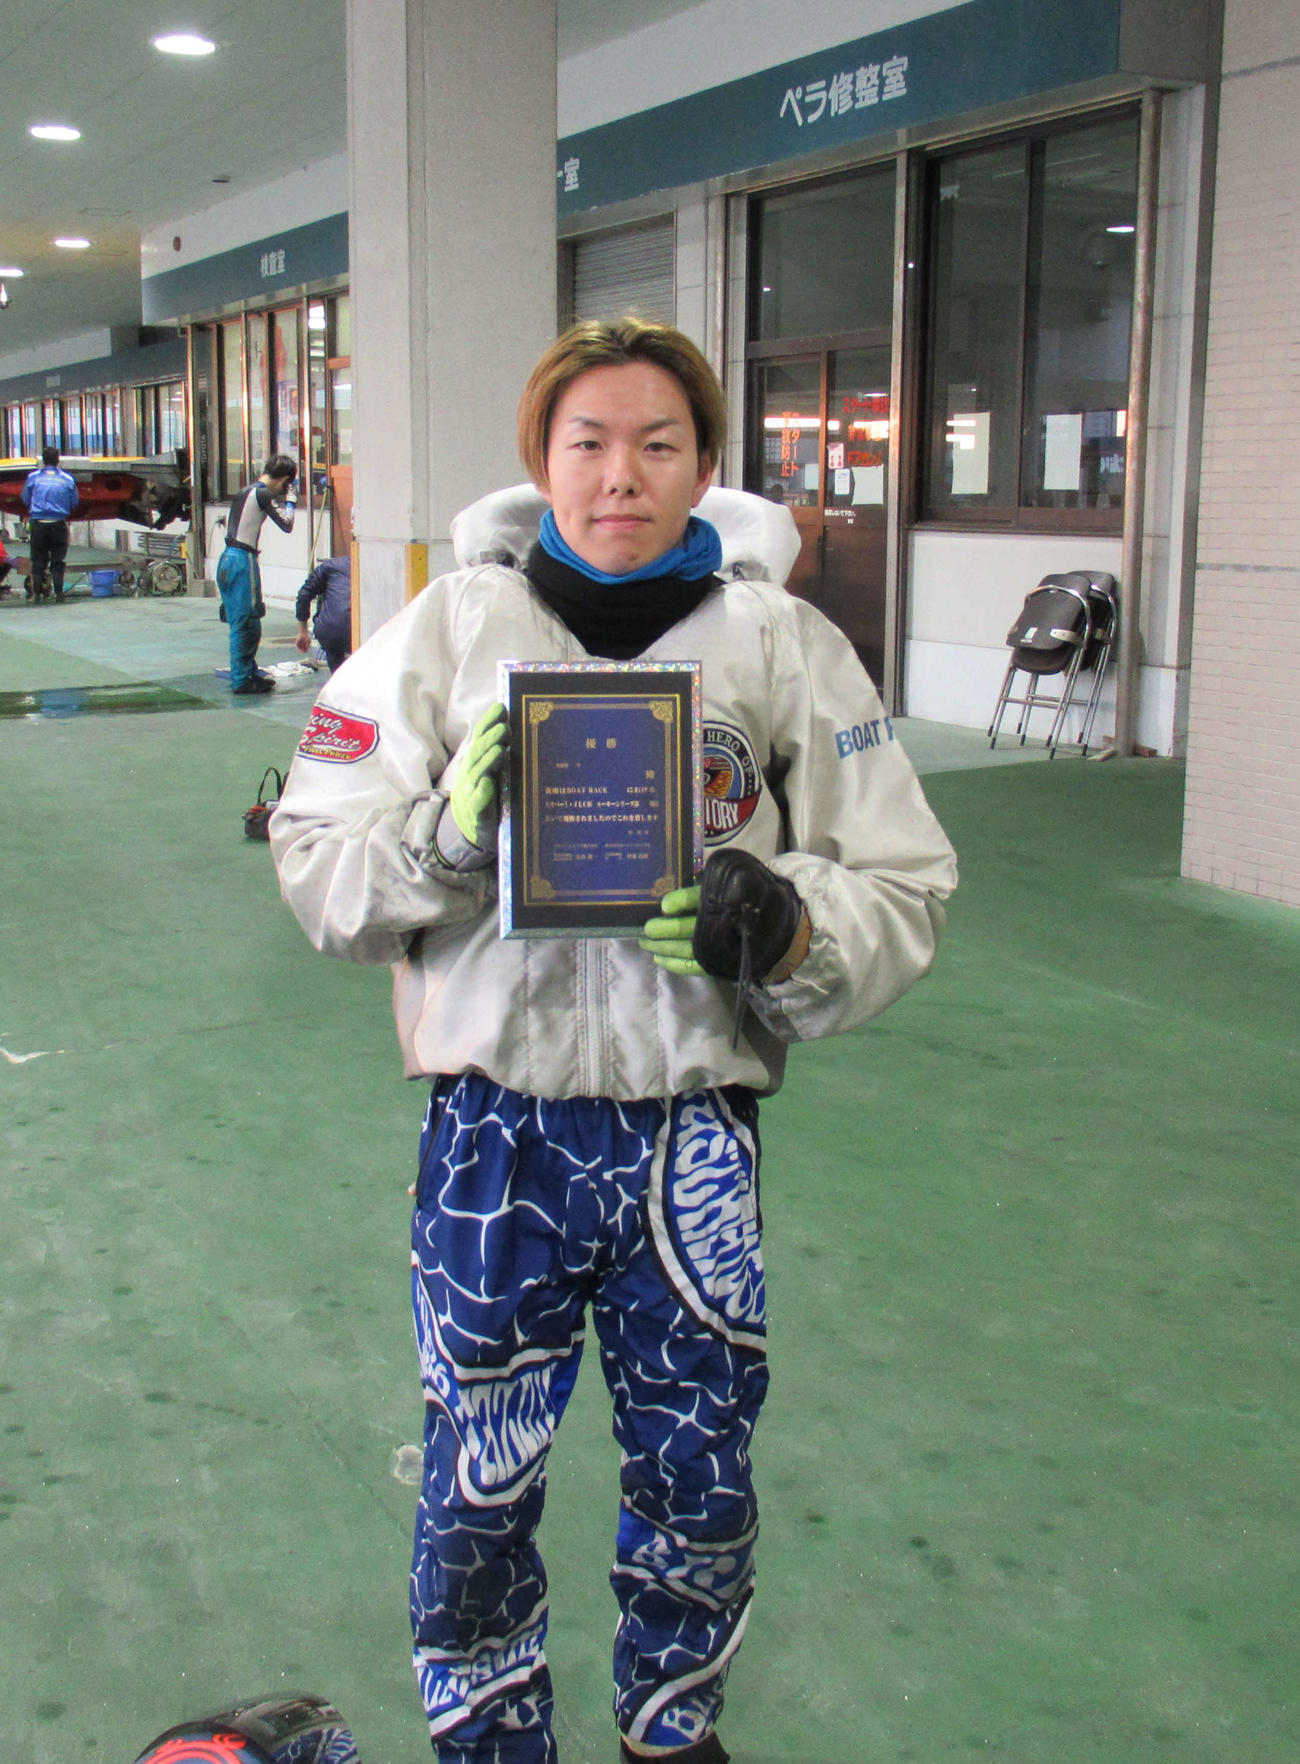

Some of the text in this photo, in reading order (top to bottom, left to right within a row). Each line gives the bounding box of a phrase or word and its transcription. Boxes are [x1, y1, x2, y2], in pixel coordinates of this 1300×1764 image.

[780, 55, 909, 127] ペラ修整室
[707, 730, 740, 752] HERO
[835, 719, 881, 759] BOAT
